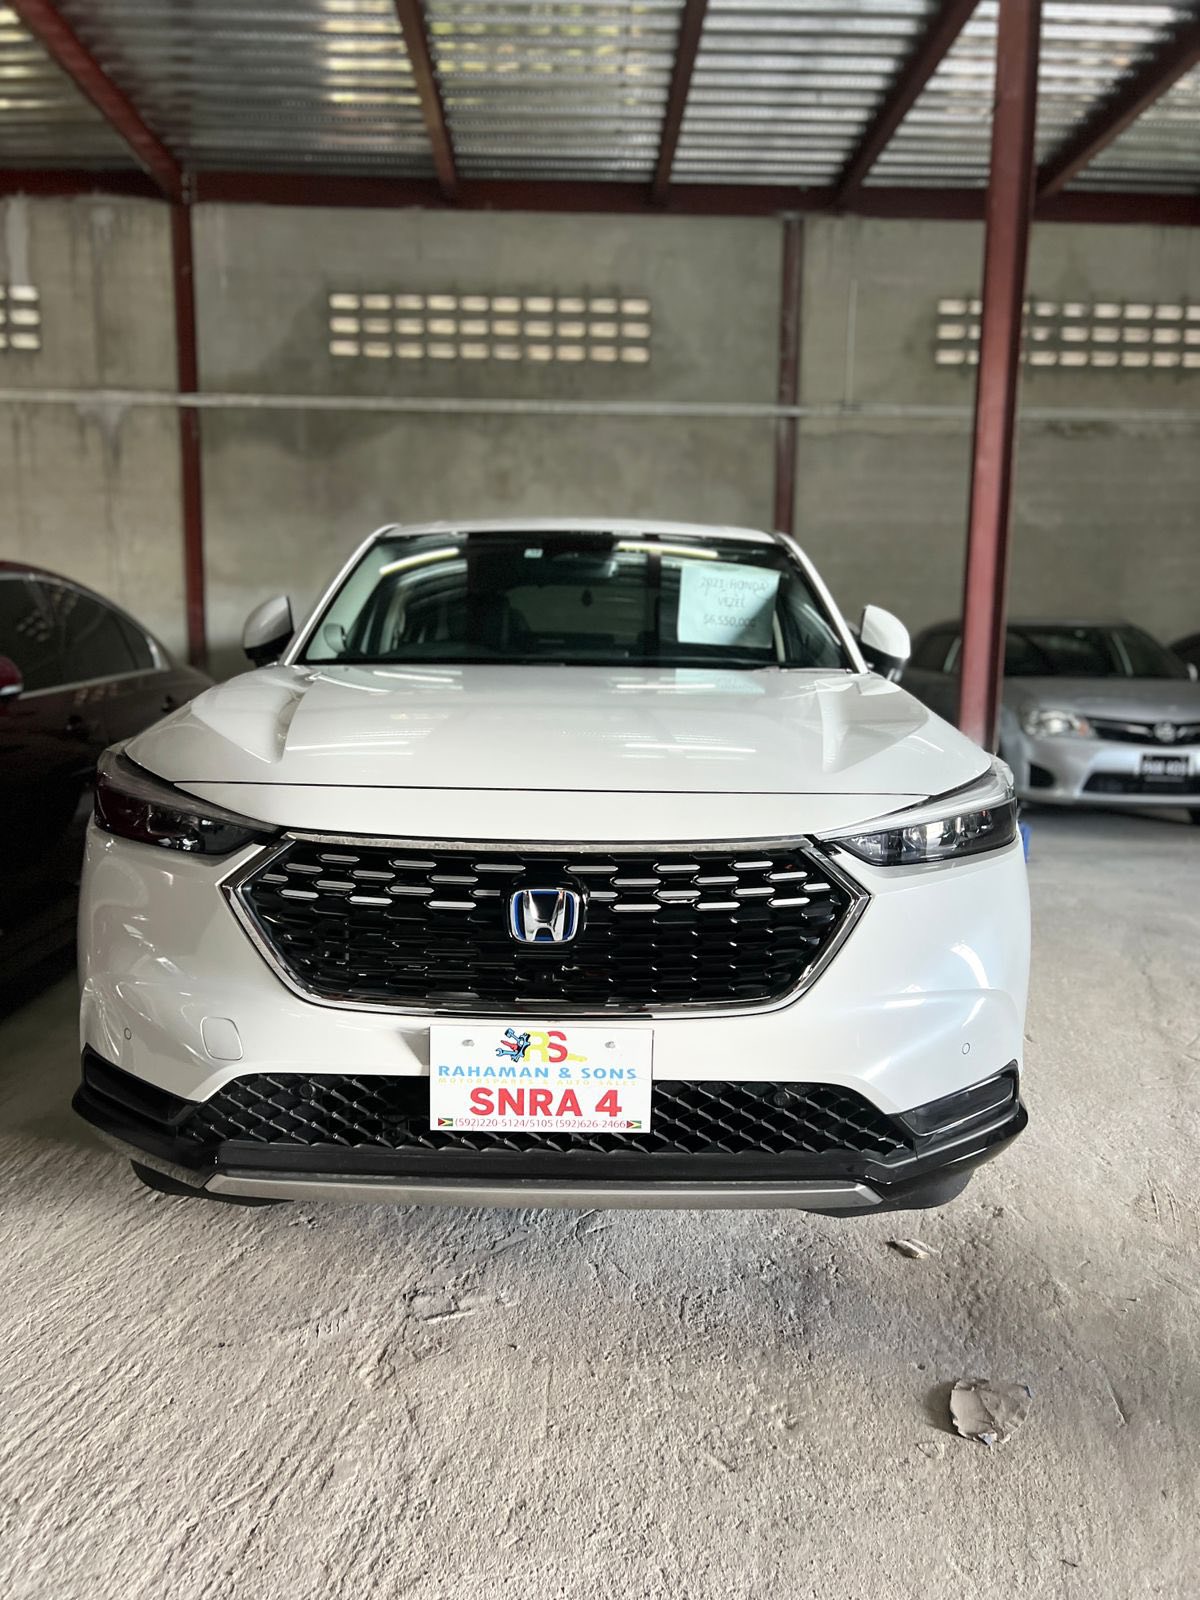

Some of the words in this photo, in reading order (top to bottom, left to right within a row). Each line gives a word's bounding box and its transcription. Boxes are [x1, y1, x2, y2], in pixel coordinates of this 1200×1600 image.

[438, 1065, 549, 1079] RAHAMAN
[558, 1067, 572, 1079] &
[581, 1067, 637, 1080] SONS
[469, 1087, 583, 1117] SNRA
[595, 1089, 622, 1117] 4
[455, 1118, 553, 1130] (592)220-5124/5105
[555, 1118, 626, 1130] (592)626-2466
